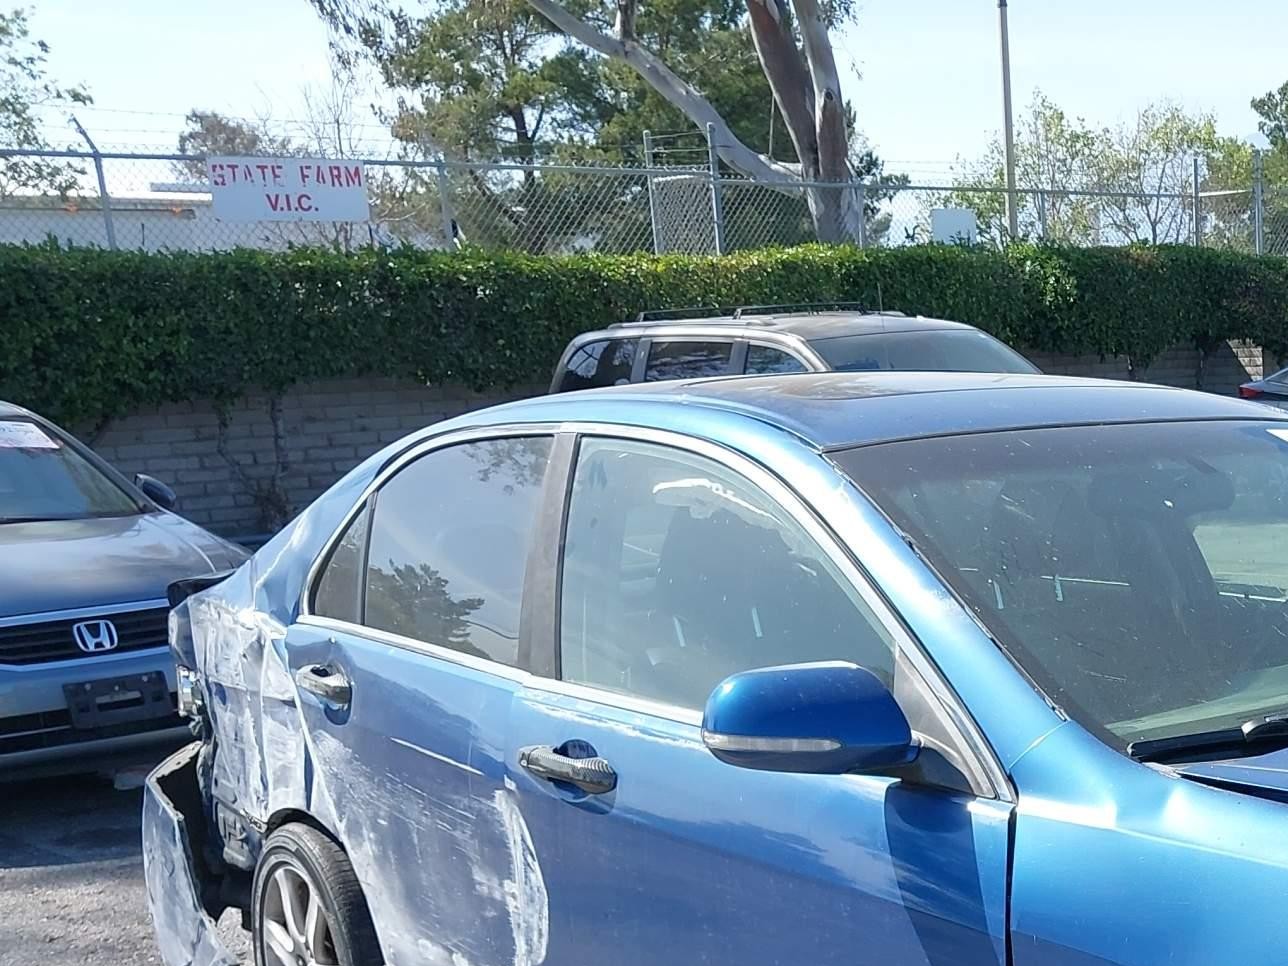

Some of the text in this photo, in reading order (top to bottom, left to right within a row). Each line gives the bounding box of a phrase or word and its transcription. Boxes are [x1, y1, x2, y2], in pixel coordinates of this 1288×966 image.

[211, 163, 362, 188] STATE FARM
[265, 193, 319, 212] V.I.C.
